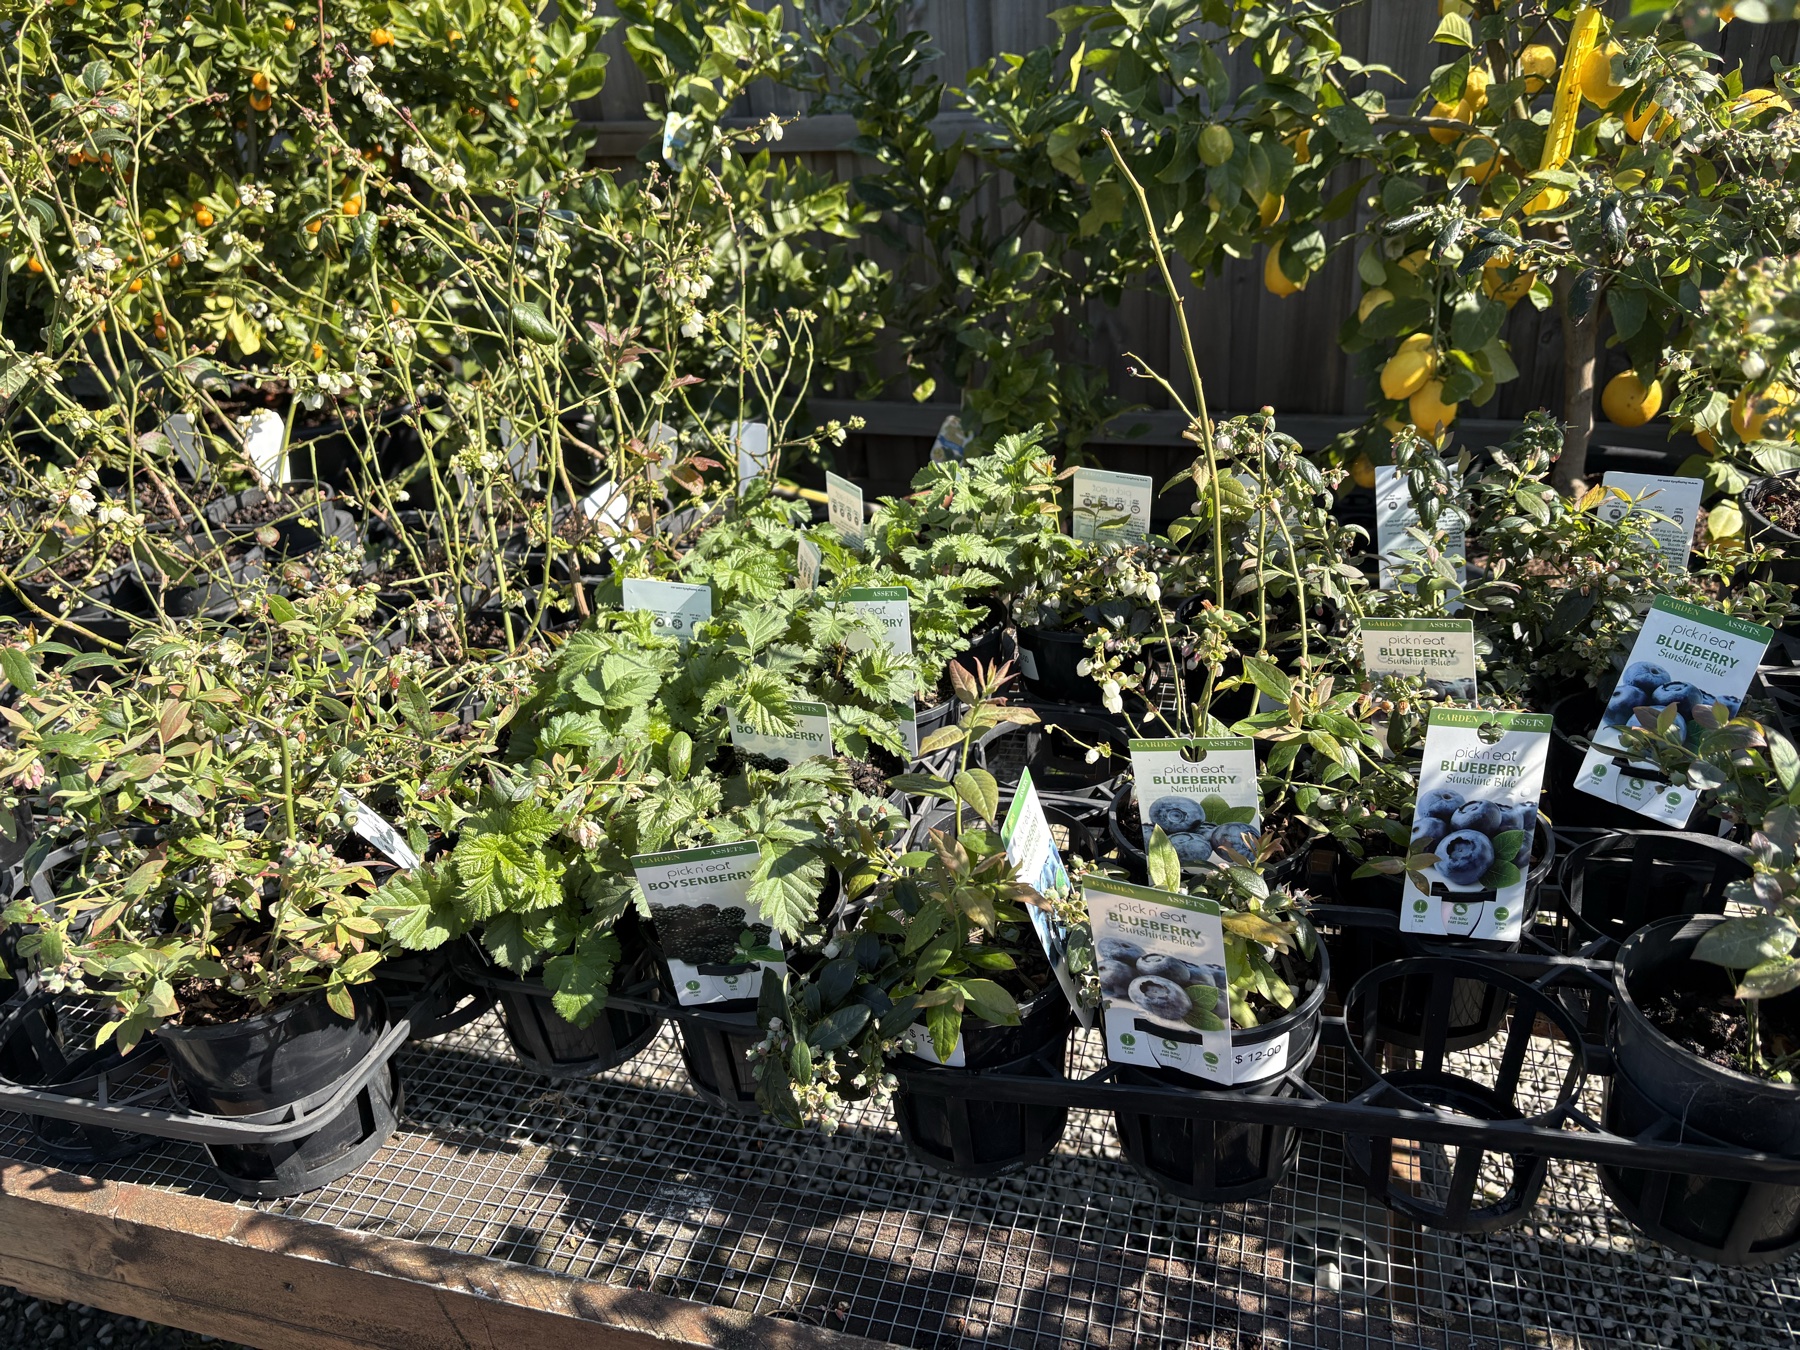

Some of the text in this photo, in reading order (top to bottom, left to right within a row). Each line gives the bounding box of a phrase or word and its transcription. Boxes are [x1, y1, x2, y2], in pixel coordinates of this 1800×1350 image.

[1662, 599, 1701, 616] GARDEN
[1671, 624, 1700, 640] pick
[1388, 635, 1412, 646] pick
[1380, 647, 1457, 658] BLUEBERRY
[1655, 634, 1740, 669] BLUEBERRY
[1387, 657, 1451, 666] Sunshine Blue
[1658, 648, 1727, 677] Sunshine Blue
[1437, 713, 1479, 723] GARDEN
[1454, 747, 1480, 760] pick
[1164, 764, 1189, 776] pick
[1440, 760, 1526, 777] BLUEBERRY
[1152, 775, 1237, 785] BLUEBERRY
[1445, 773, 1517, 788] Sunshine Blue
[1171, 784, 1221, 793] Northland
[640, 854, 681, 865] GARDEN
[667, 866, 693, 879] pick
[648, 869, 756, 891] BOYSENBERRY
[1092, 880, 1135, 894] GARDEN
[1118, 902, 1147, 914] pick
[1108, 911, 1201, 940] BLUEBERRY
[1118, 924, 1196, 948] Sunshine Blue
[1234, 1054, 1243, 1065] $
